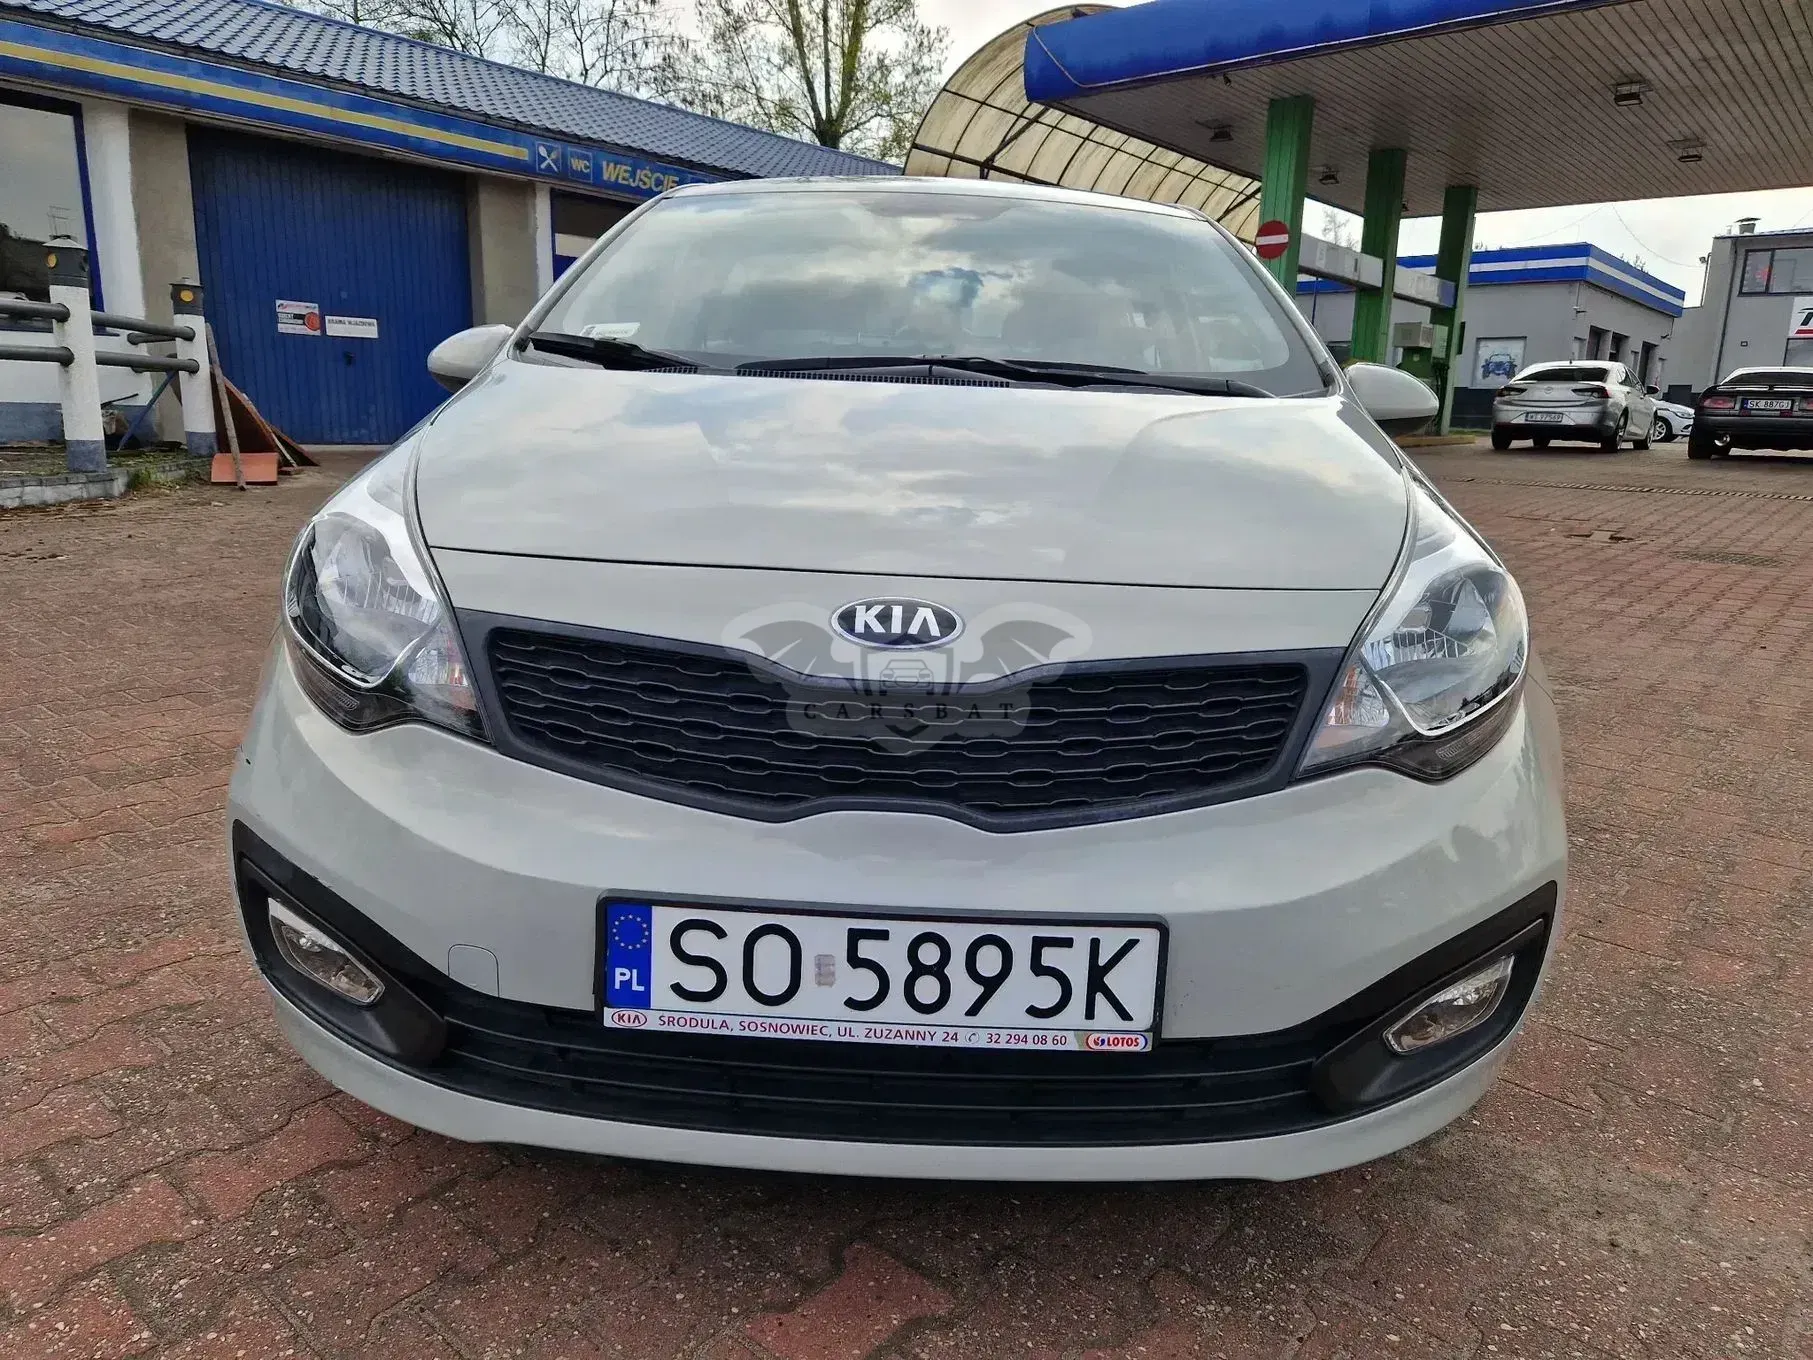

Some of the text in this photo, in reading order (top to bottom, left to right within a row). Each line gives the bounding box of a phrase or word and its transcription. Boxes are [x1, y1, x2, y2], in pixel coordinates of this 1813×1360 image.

[570, 157, 591, 173] WC
[602, 160, 680, 192] WEJŚCIE
[1749, 400, 1761, 408] SK
[854, 604, 941, 637] KIA
[614, 967, 645, 991] PL
[669, 918, 1141, 1022] SO 5895K
[617, 1013, 642, 1025] KIA
[738, 1020, 832, 1038] SOSNOWIEC,
[837, 1026, 859, 1038] UL.
[864, 1027, 938, 1042] ZUZANNY
[941, 1031, 959, 1043] 24
[986, 1032, 1001, 1044] 32
[1005, 1033, 1028, 1045] 294
[1032, 1034, 1048, 1045] 08
[1052, 1034, 1067, 1046] 60
[1106, 1036, 1140, 1048] LOTOS
